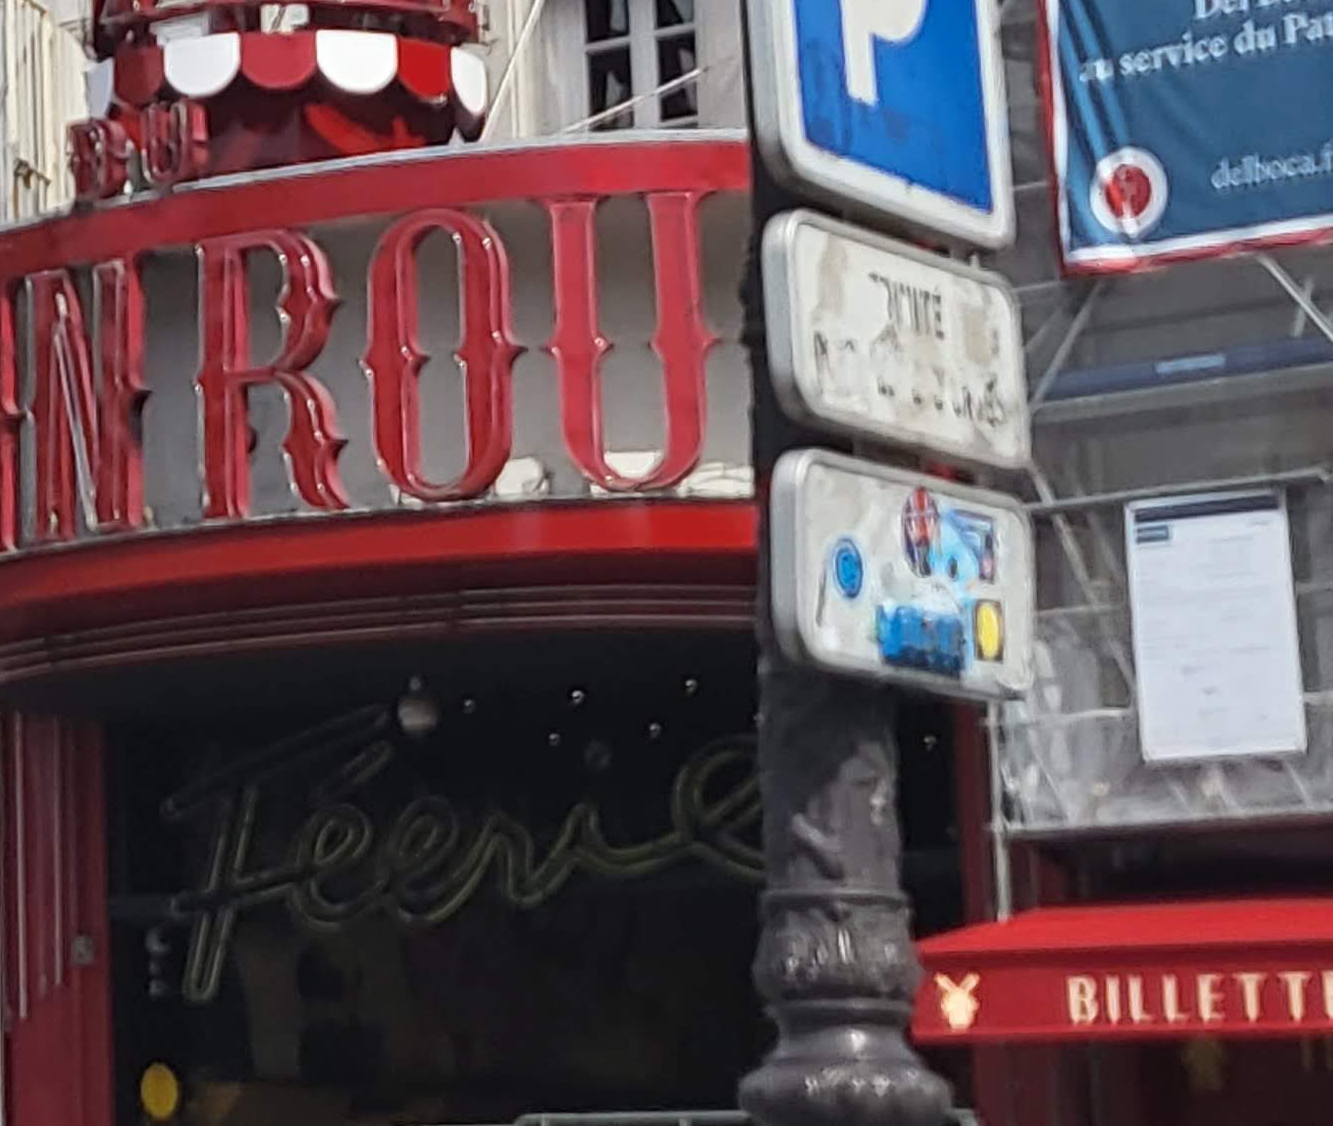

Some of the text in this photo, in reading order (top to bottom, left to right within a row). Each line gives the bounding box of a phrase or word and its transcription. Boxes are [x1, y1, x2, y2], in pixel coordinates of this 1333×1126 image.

[1119, 31, 1229, 76] service
[1234, 20, 1277, 55] du
[193, 186, 721, 520] ROU
